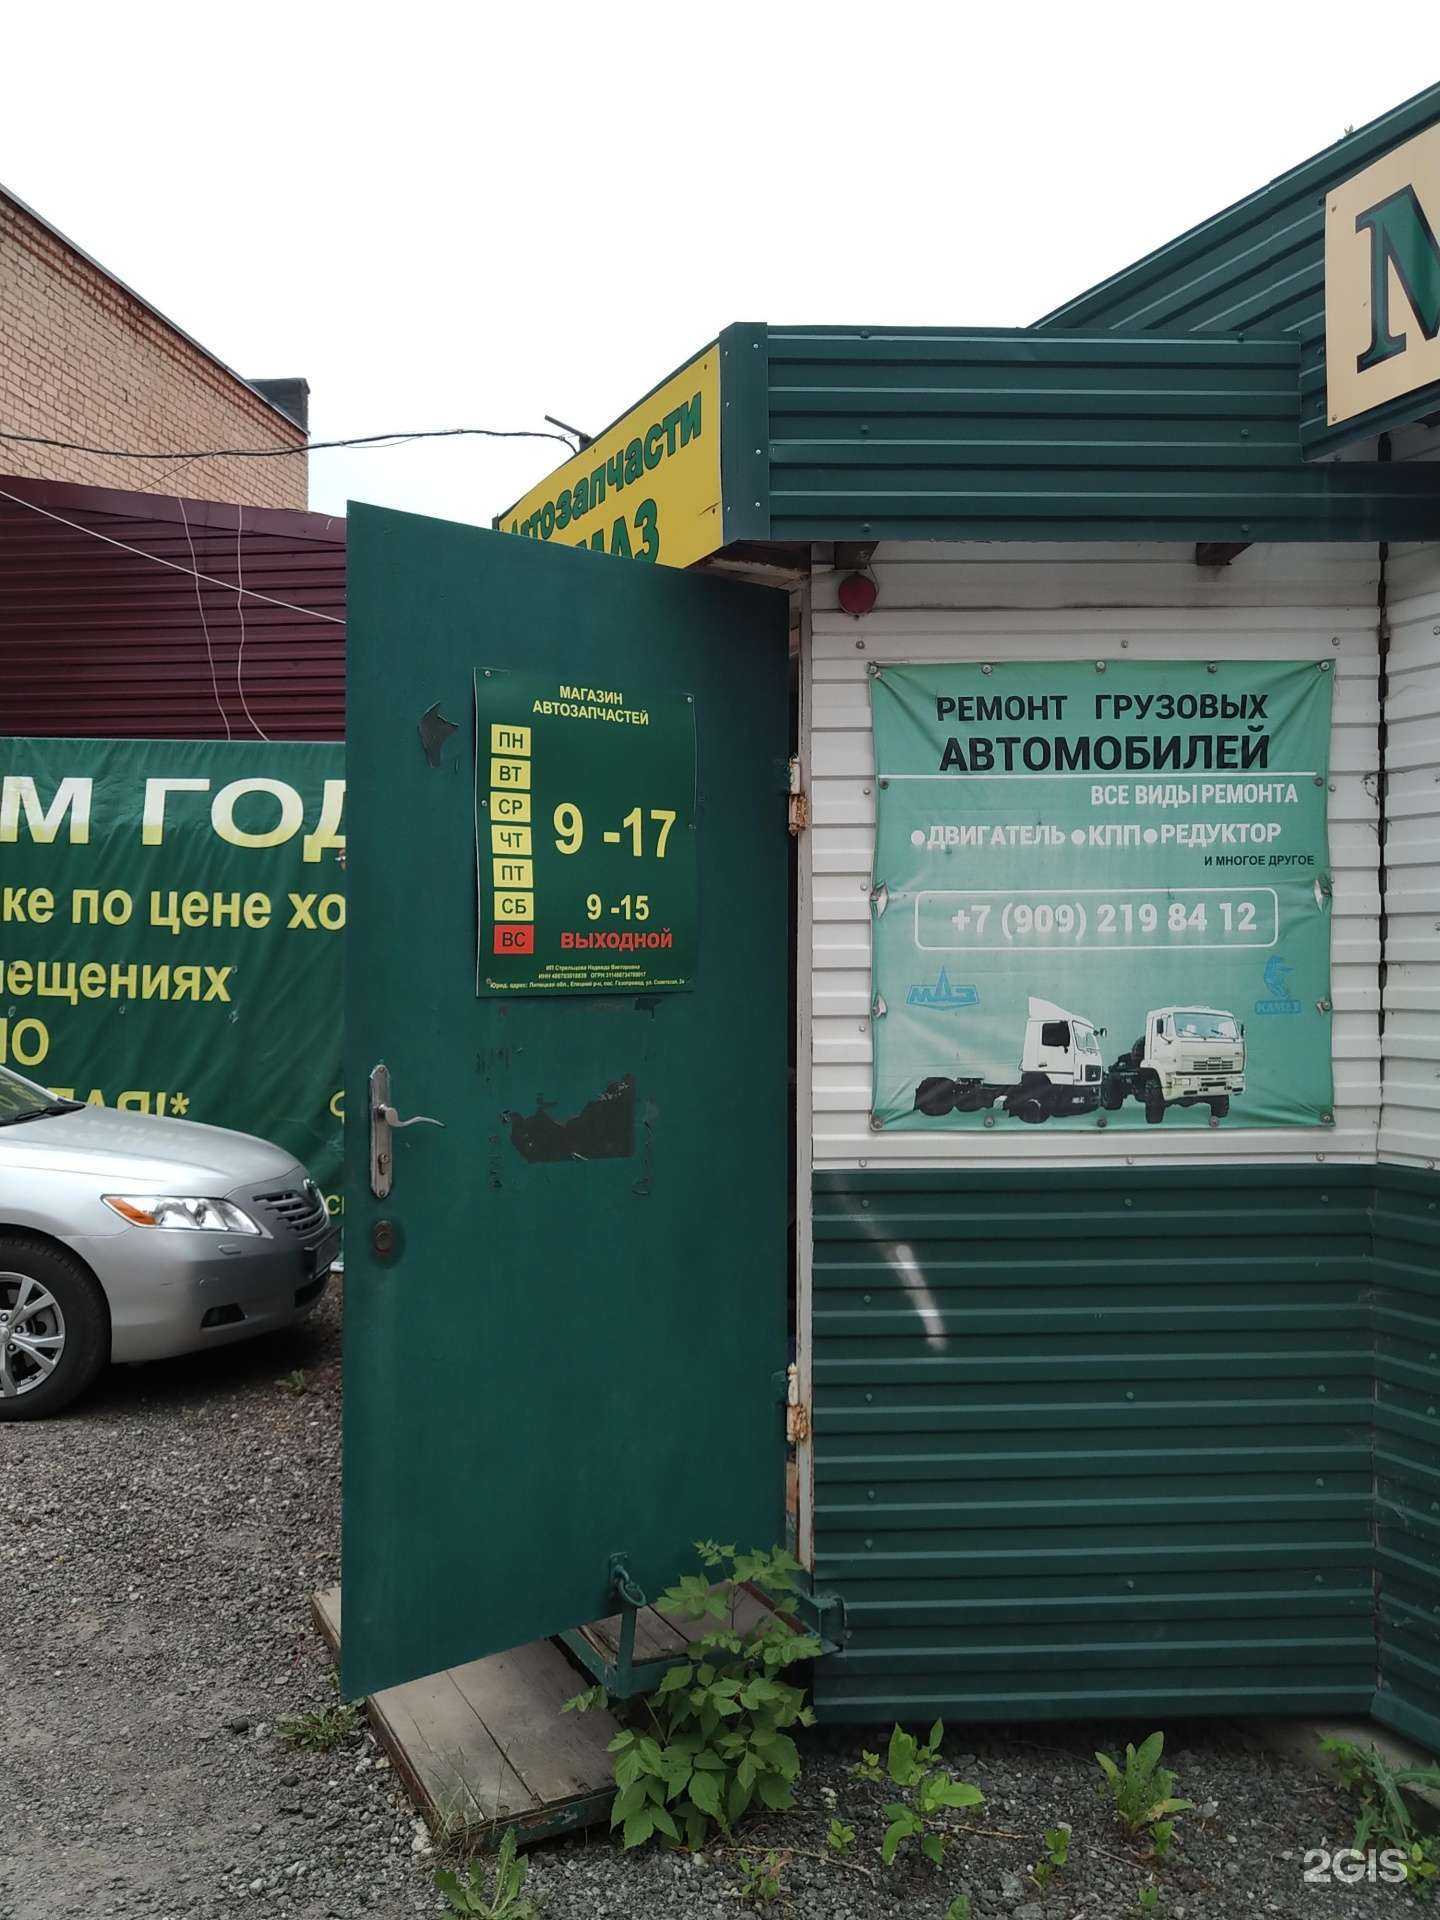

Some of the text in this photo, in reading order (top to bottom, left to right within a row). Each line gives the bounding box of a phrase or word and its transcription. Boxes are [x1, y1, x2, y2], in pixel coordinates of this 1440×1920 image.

[560, 686, 623, 705] МАГАЗИН
[936, 694, 1269, 722] РЕМОНТ ГРУЗОВЫХ
[533, 700, 649, 725] АВТОЗАПЧАСТЕЙ
[499, 731, 524, 749] ПН
[939, 724, 1271, 772] АВТОМОБИЛЕЙ
[499, 765, 522, 782] ВТ
[498, 799, 523, 815] СР
[1091, 783, 1299, 809] ВСЕ ВИДЫ РЕМОНТА
[500, 832, 523, 848] ЧТ
[553, 802, 584, 855] 9
[927, 823, 1282, 850] ДВИГАТЕЛЬ КПП РЕДУКТОР
[501, 865, 525, 881] ПТ
[1204, 855, 1315, 867] И МНОГОЕ ДРУГОЕ
[72, 889, 133, 925] по
[150, 891, 272, 935] цене
[502, 898, 527, 914] СБ
[586, 893, 602, 921] 9
[952, 902, 1257, 940] +7 (909) 219 84 12
[502, 932, 526, 948] ВС
[560, 928, 673, 952] ВЫХОДНОЙ
[0, 960, 232, 1005] ещениях
[0, 1017, 50, 1066] О
